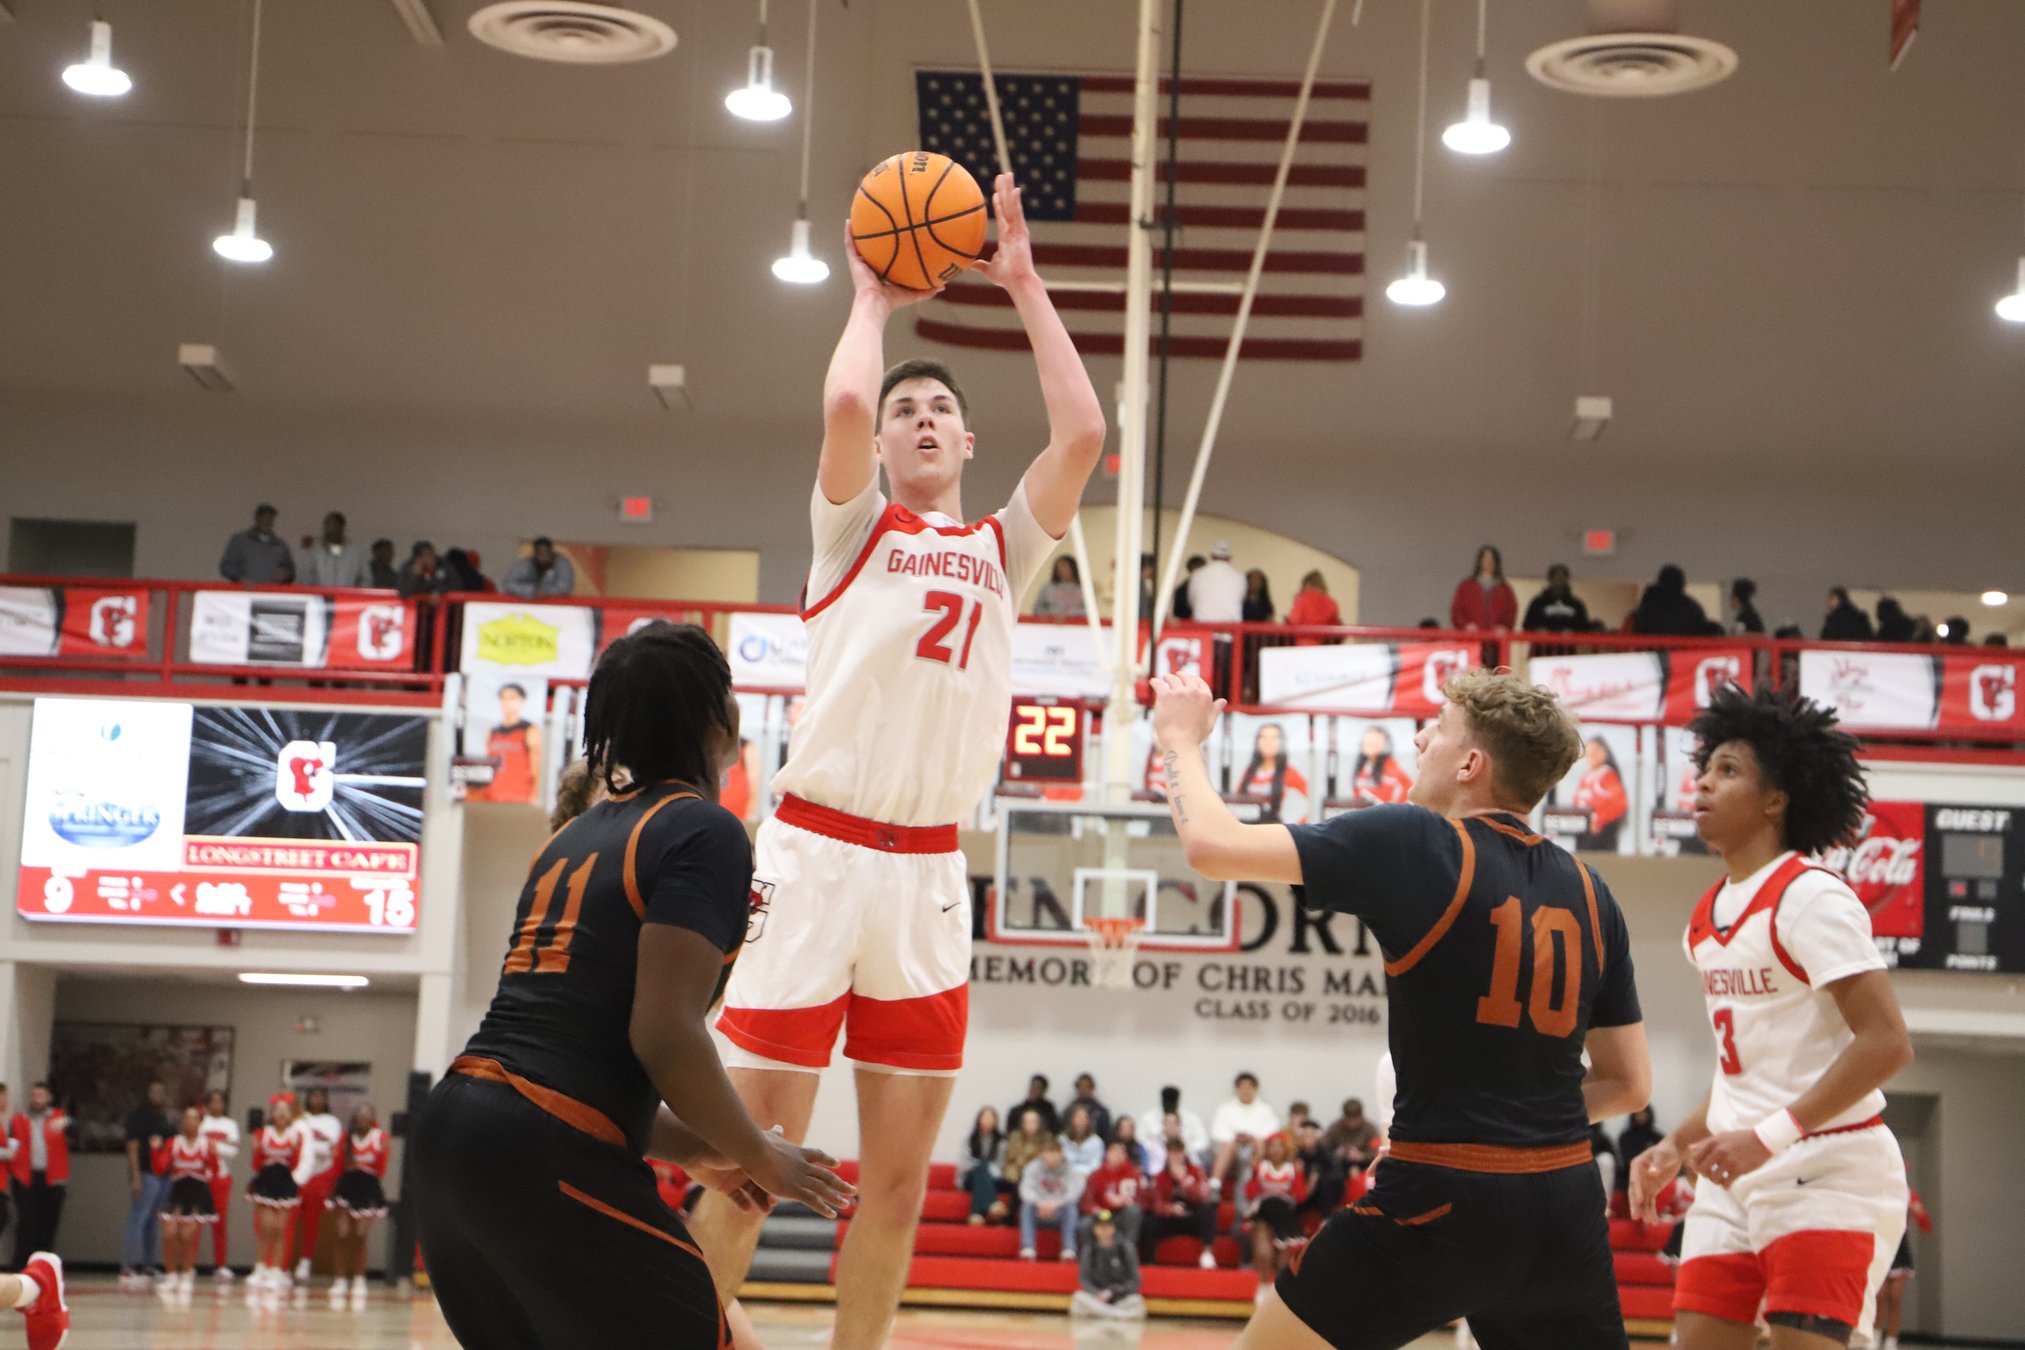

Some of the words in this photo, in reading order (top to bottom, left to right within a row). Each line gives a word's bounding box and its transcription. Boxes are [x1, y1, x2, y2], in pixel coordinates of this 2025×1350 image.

[915, 590, 983, 670] 21
[1014, 705, 1076, 756] 22
[1936, 809, 2011, 830] GUEST
[363, 889, 415, 926] 15
[503, 852, 599, 974] 11
[1132, 959, 1184, 990] OF
[1198, 962, 1305, 994] CHRIS
[1323, 968, 1388, 998] MA
[1476, 895, 1583, 1038] 10
[1195, 998, 1271, 1019] CLASS
[1282, 1001, 1317, 1021] OF
[1327, 1003, 1381, 1024] 2016
[1713, 1007, 1742, 1075] 3
